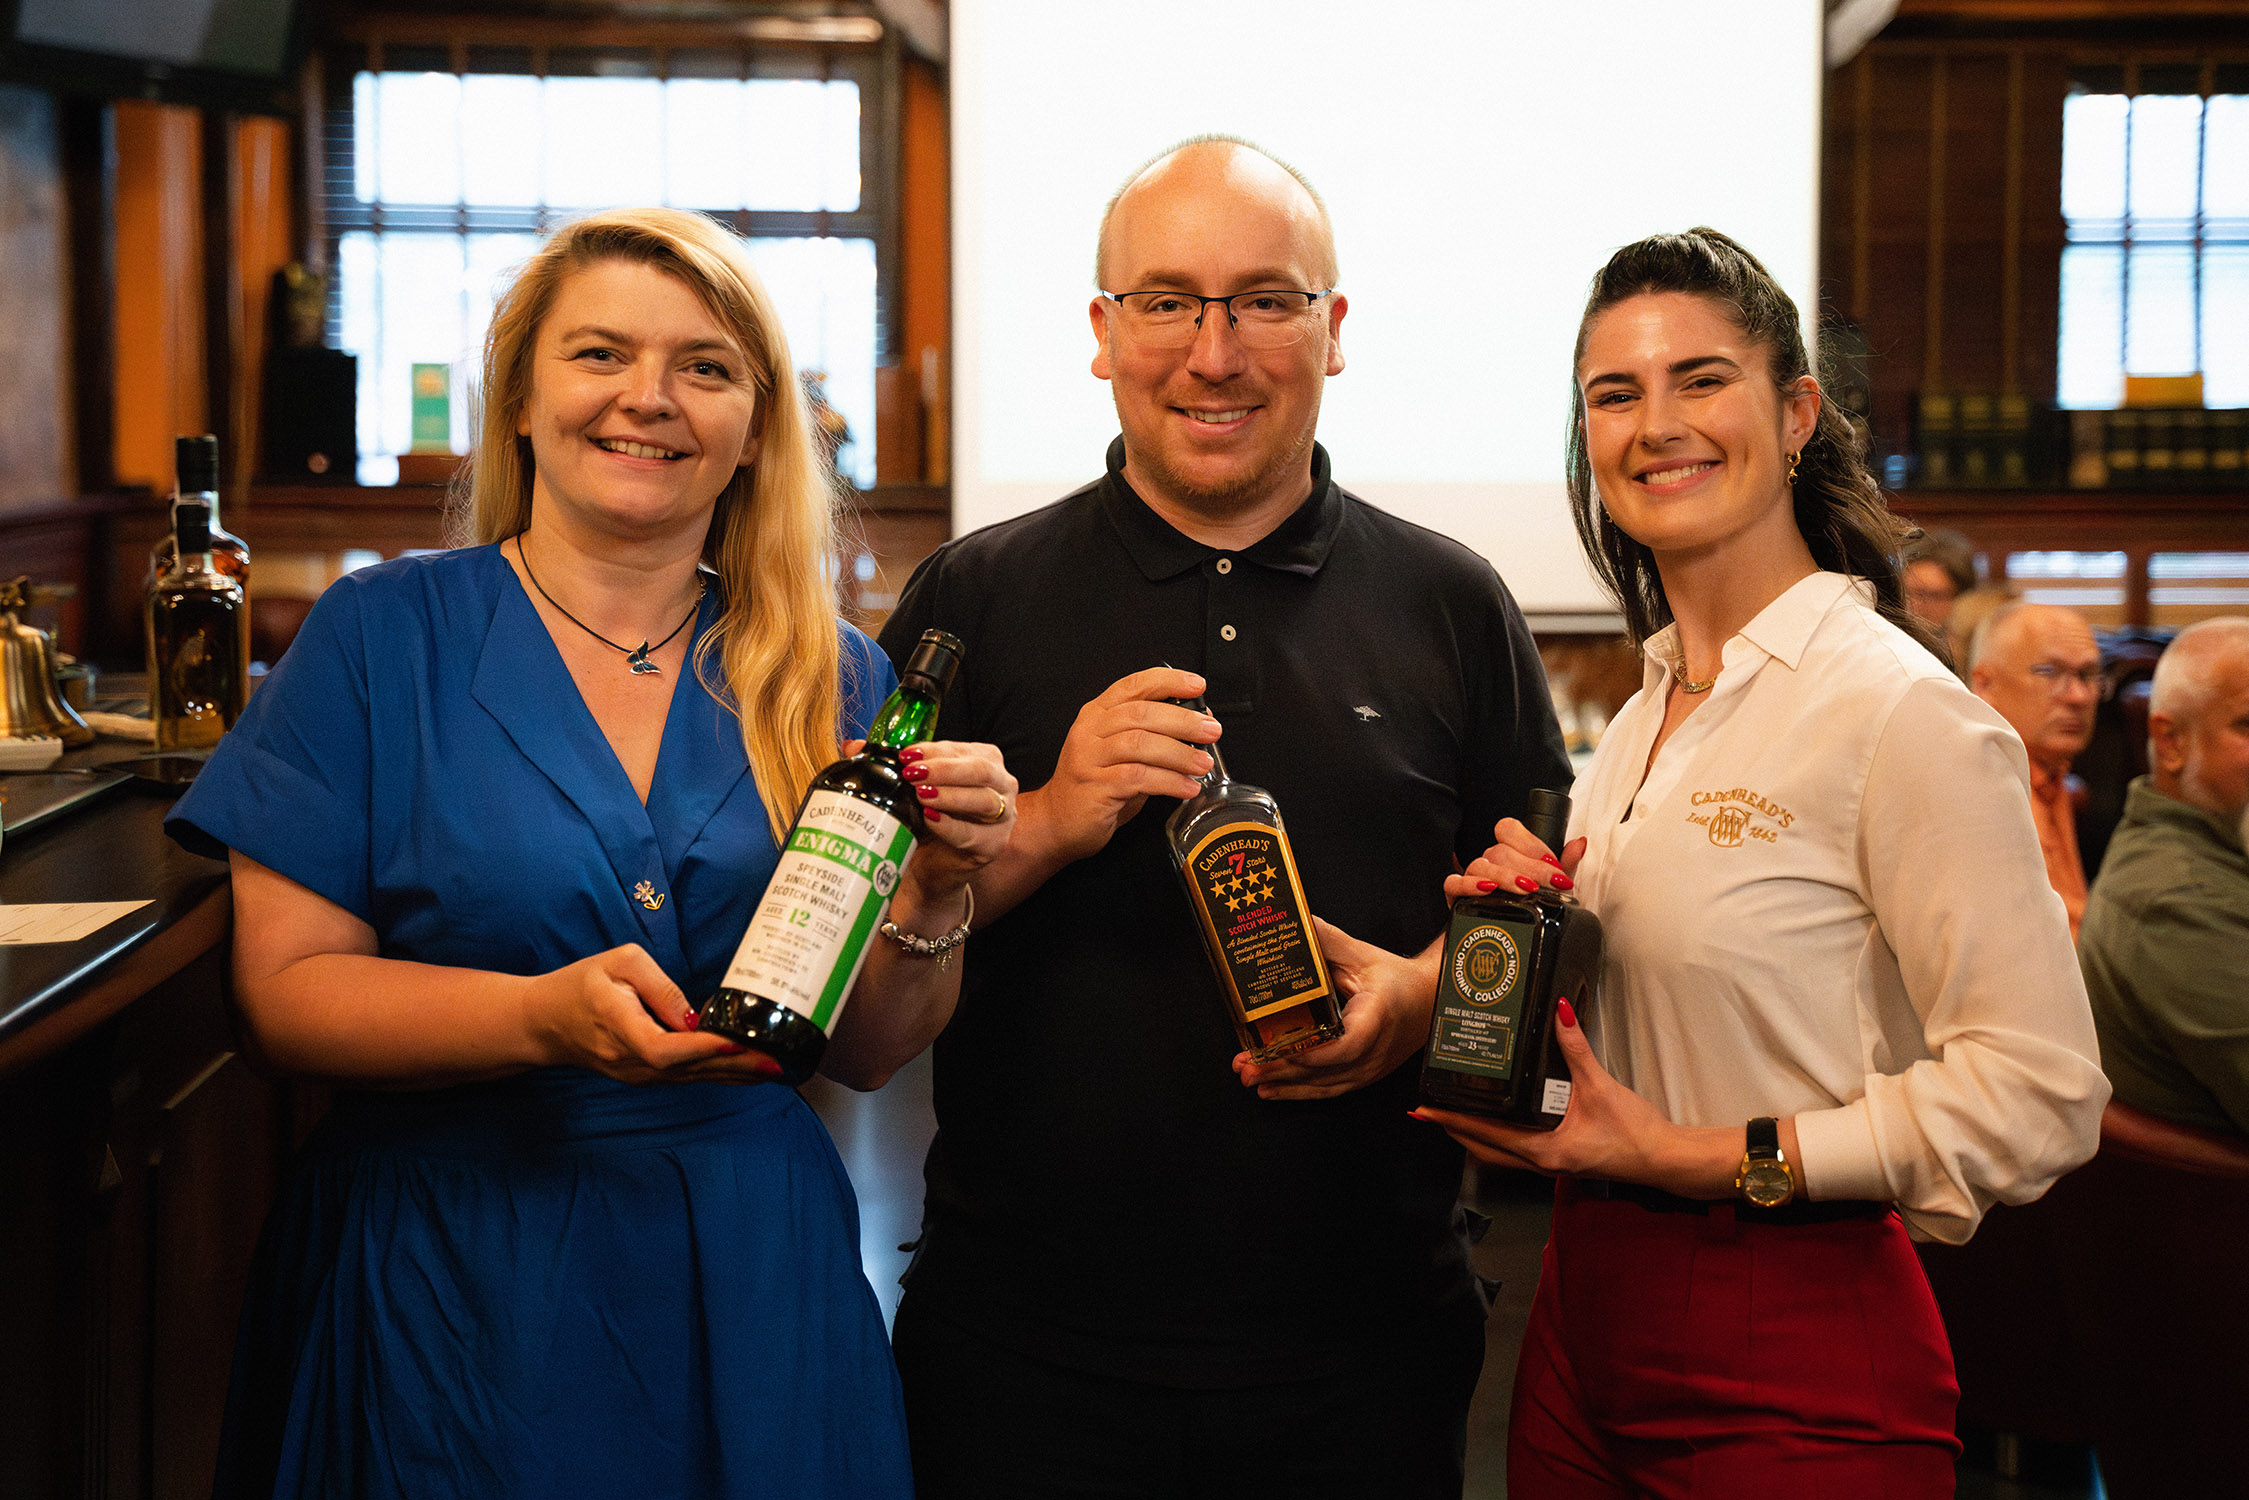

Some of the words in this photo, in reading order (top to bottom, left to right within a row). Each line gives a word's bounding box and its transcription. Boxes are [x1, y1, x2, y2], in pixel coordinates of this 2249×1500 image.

[1691, 788, 1795, 828] CADENHEAD'S
[809, 806, 885, 842] CADENHEAD'S
[795, 832, 871, 872] ENIGMA
[1199, 839, 1270, 871] CADENHEAD'S
[1228, 852, 1245, 875] 7
[797, 862, 844, 887] SPEYSIDE
[1209, 868, 1233, 880] Seven
[1246, 856, 1266, 868] Stars
[784, 874, 818, 890] SINGLE
[820, 884, 846, 903] MALT
[772, 885, 808, 900] SCOTCH
[810, 895, 849, 919] WHISKY
[1236, 905, 1273, 923] BLENDED
[788, 908, 811, 927] 12
[1228, 920, 1257, 936] SCOTCH
[1257, 910, 1288, 926] WHISKY
[1233, 941, 1267, 956] containing
[1267, 937, 1278, 945] the
[1278, 930, 1298, 943] finest
[1236, 933, 1259, 946] Blended
[1259, 926, 1278, 938] Scotch
[1278, 921, 1298, 931] Whisky
[1463, 929, 1515, 955] CADENHEADS
[1235, 953, 1255, 965] Single
[1255, 948, 1269, 958] Malt
[1269, 943, 1283, 953] and
[1283, 939, 1301, 951] Grain
[1455, 952, 1472, 998] ORIGINAL
[1475, 959, 1516, 1002] COLLECTION
[1444, 1007, 1461, 1017] SINGLE
[1461, 1010, 1474, 1018] MALT
[1474, 1011, 1492, 1021] SCOTCH
[1492, 1014, 1511, 1024] WHISKY
